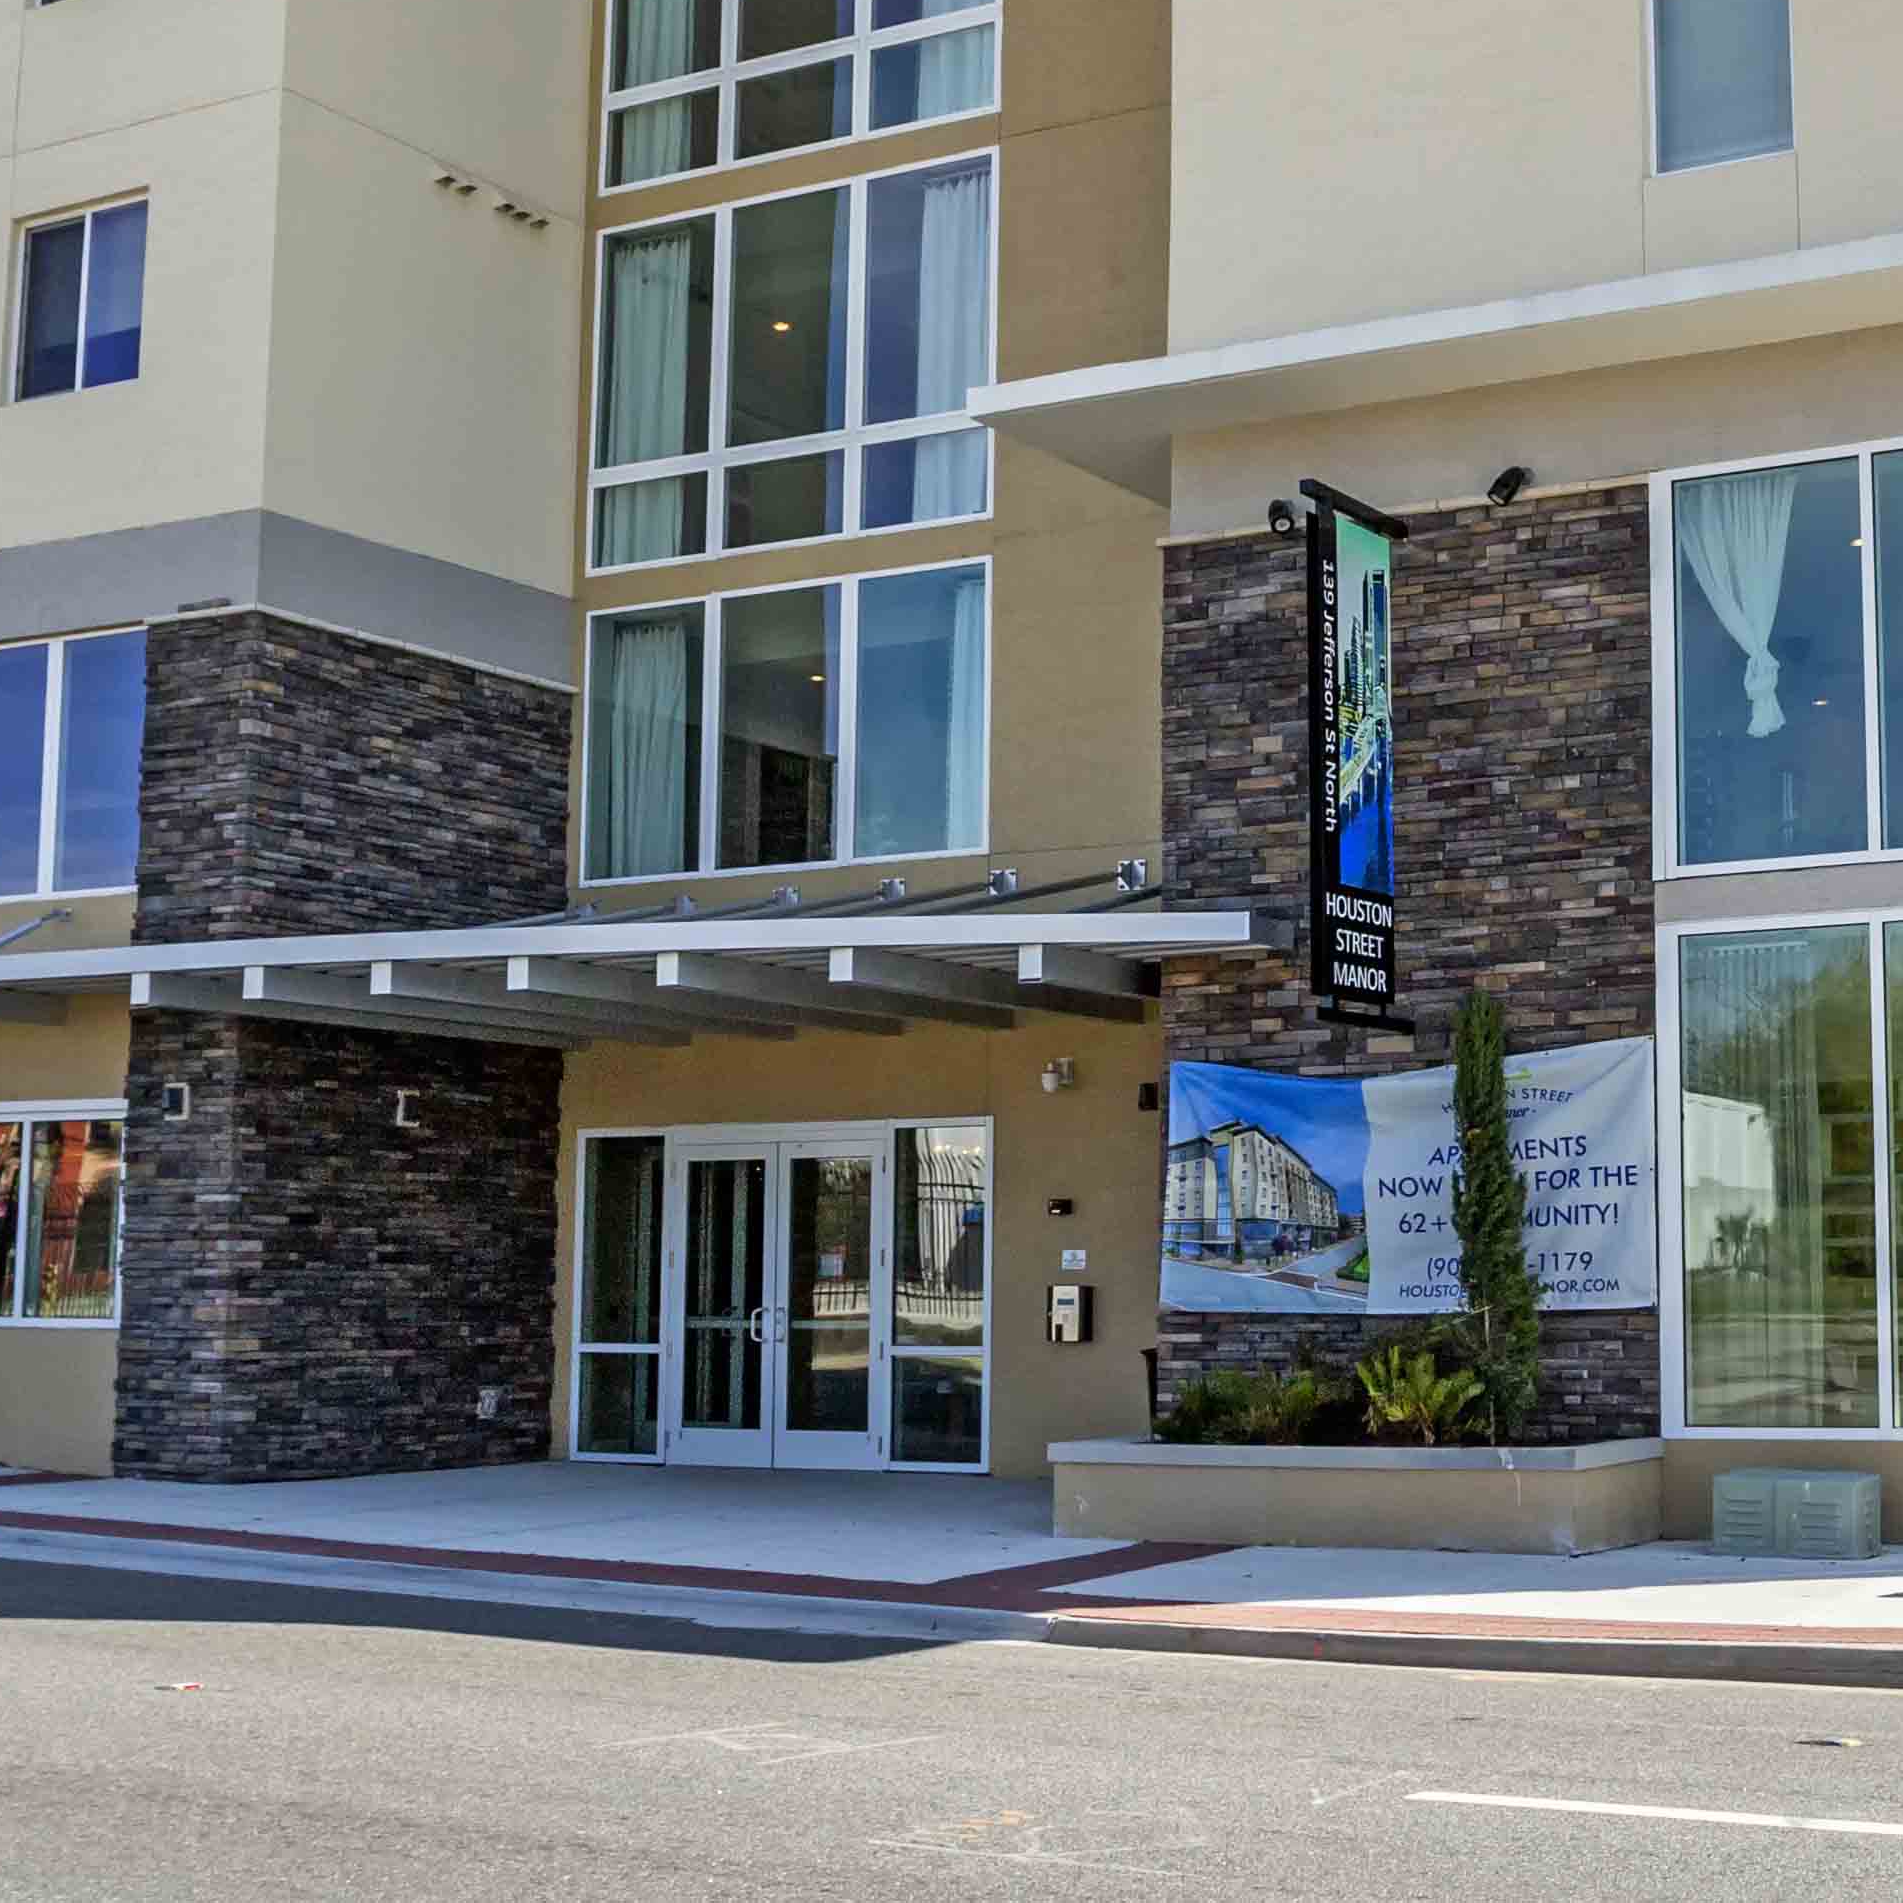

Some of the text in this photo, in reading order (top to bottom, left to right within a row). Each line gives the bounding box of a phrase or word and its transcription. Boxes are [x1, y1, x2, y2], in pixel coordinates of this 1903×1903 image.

[1322, 559, 1338, 832] 139 Jefferson St North
[1326, 892, 1392, 928] HOUSTON
[1335, 928, 1384, 959] STREET
[1333, 961, 1387, 993] MANOR
[1521, 1088, 1574, 1103] STREET
[1428, 1135, 1586, 1165] APMENTS
[1378, 1176, 1443, 1198] NOW
[1535, 1168, 1580, 1191] FOR
[1588, 1165, 1638, 1187] THE
[1399, 1212, 1447, 1233] 62+
